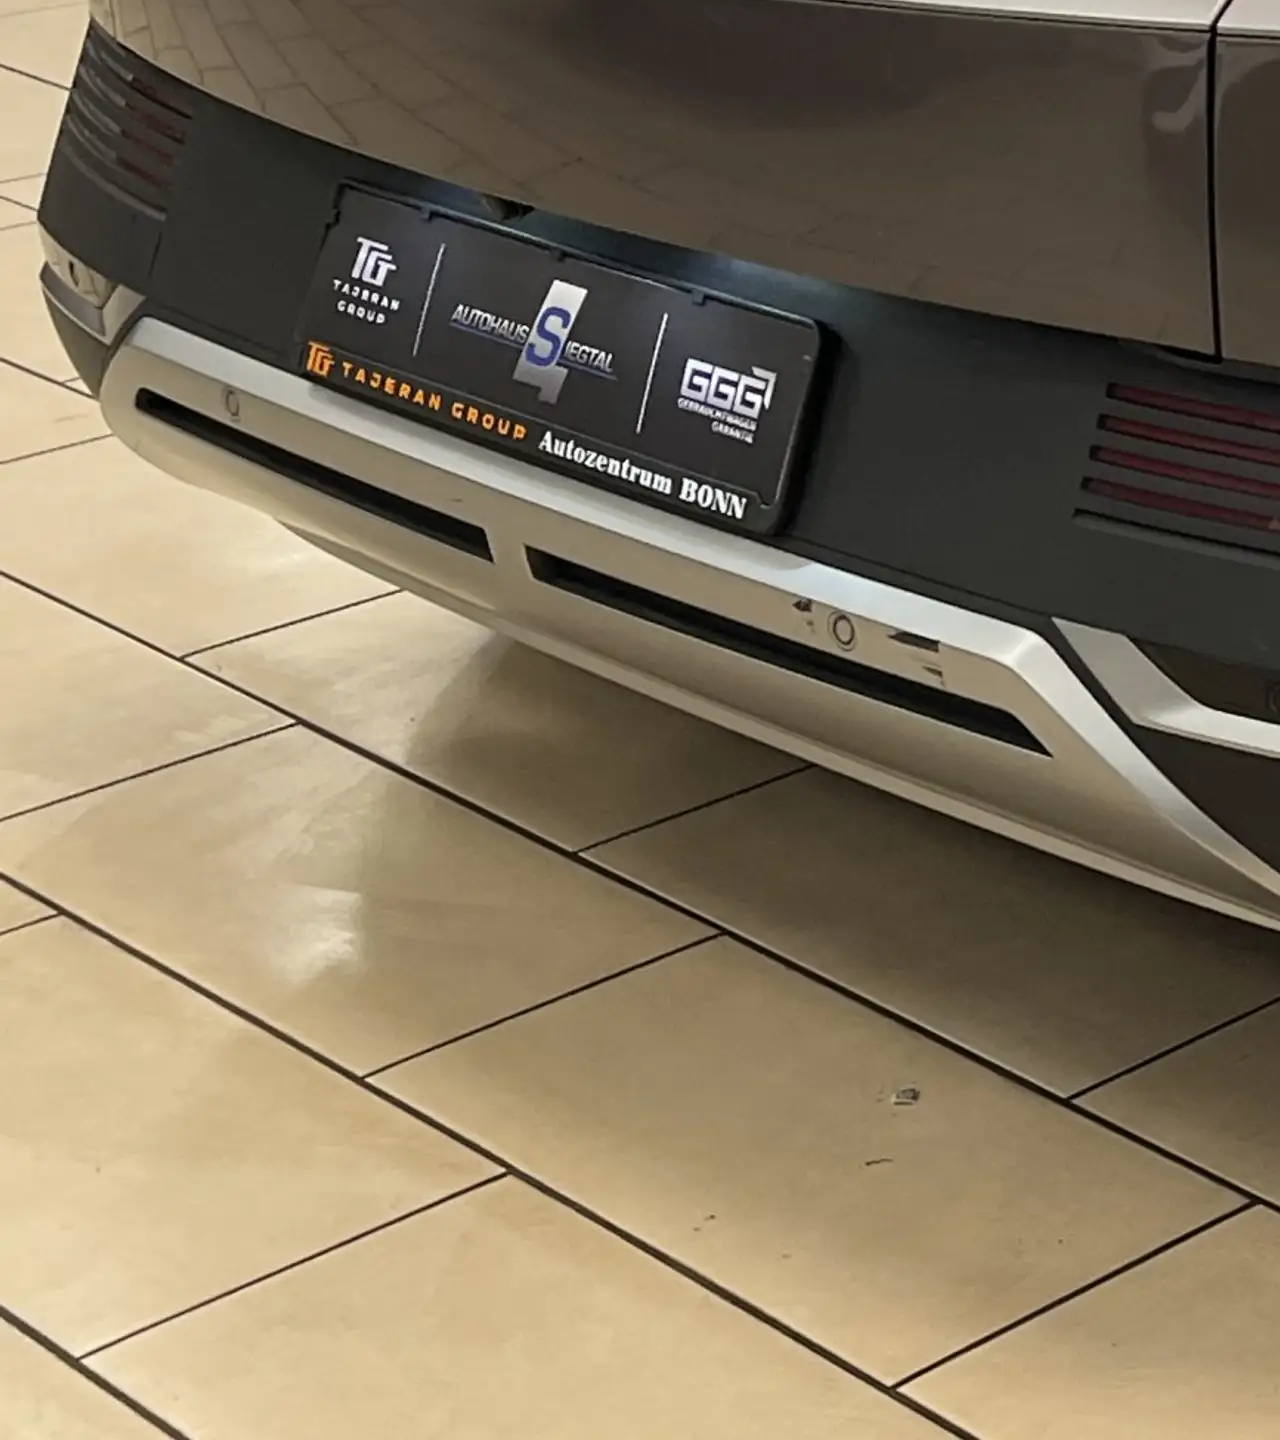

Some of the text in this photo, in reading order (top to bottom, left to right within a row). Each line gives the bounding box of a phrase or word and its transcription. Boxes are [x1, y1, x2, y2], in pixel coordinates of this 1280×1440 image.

[332, 278, 400, 312] TAJERAN
[337, 300, 386, 324] GROUP
[451, 303, 530, 344] AUTOHAUS
[681, 358, 768, 419] GGG
[342, 361, 441, 411] TAJERAN
[451, 401, 528, 441] GROUP
[538, 430, 673, 495] Autozentrum
[678, 476, 748, 520] BONN
